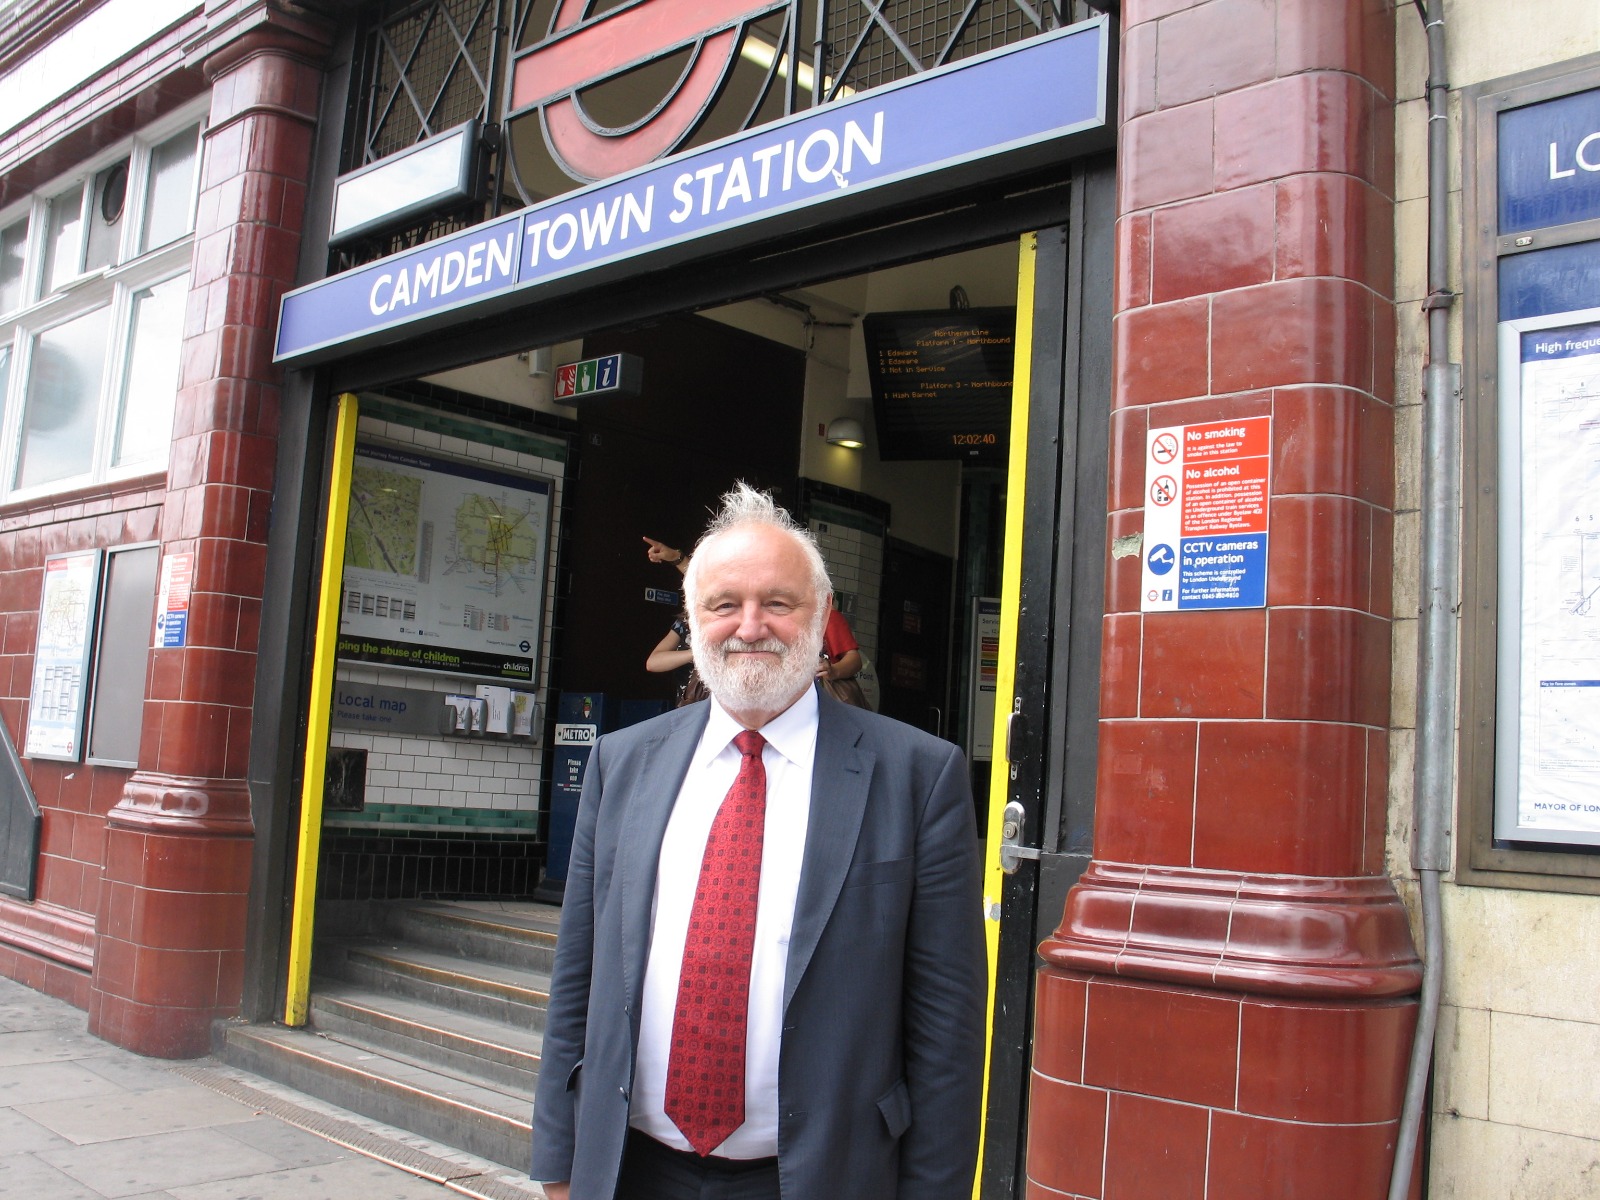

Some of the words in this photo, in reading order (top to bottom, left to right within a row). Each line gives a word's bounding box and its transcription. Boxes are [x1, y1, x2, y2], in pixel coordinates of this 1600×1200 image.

[369, 234, 515, 316] CAMDEN
[527, 185, 655, 268] TOWN
[669, 111, 885, 224] STATION
[1536, 342, 1562, 354] High
[952, 434, 996, 445] 12:02:40
[1187, 432, 1202, 441] No
[1204, 427, 1246, 439] smoking
[1186, 469, 1201, 479] No
[1203, 465, 1240, 478] alcohol
[1184, 542, 1213, 553] CCTV
[1216, 541, 1258, 551] cameras
[1183, 556, 1192, 566] in
[1195, 554, 1243, 567] operation
[362, 642, 378, 653] the
[381, 646, 409, 657] abuse
[412, 650, 421, 659] of
[423, 652, 460, 663] children
[338, 692, 374, 708] Local
[380, 699, 406, 714] map
[338, 710, 360, 719] Please
[563, 729, 590, 740] METRO
